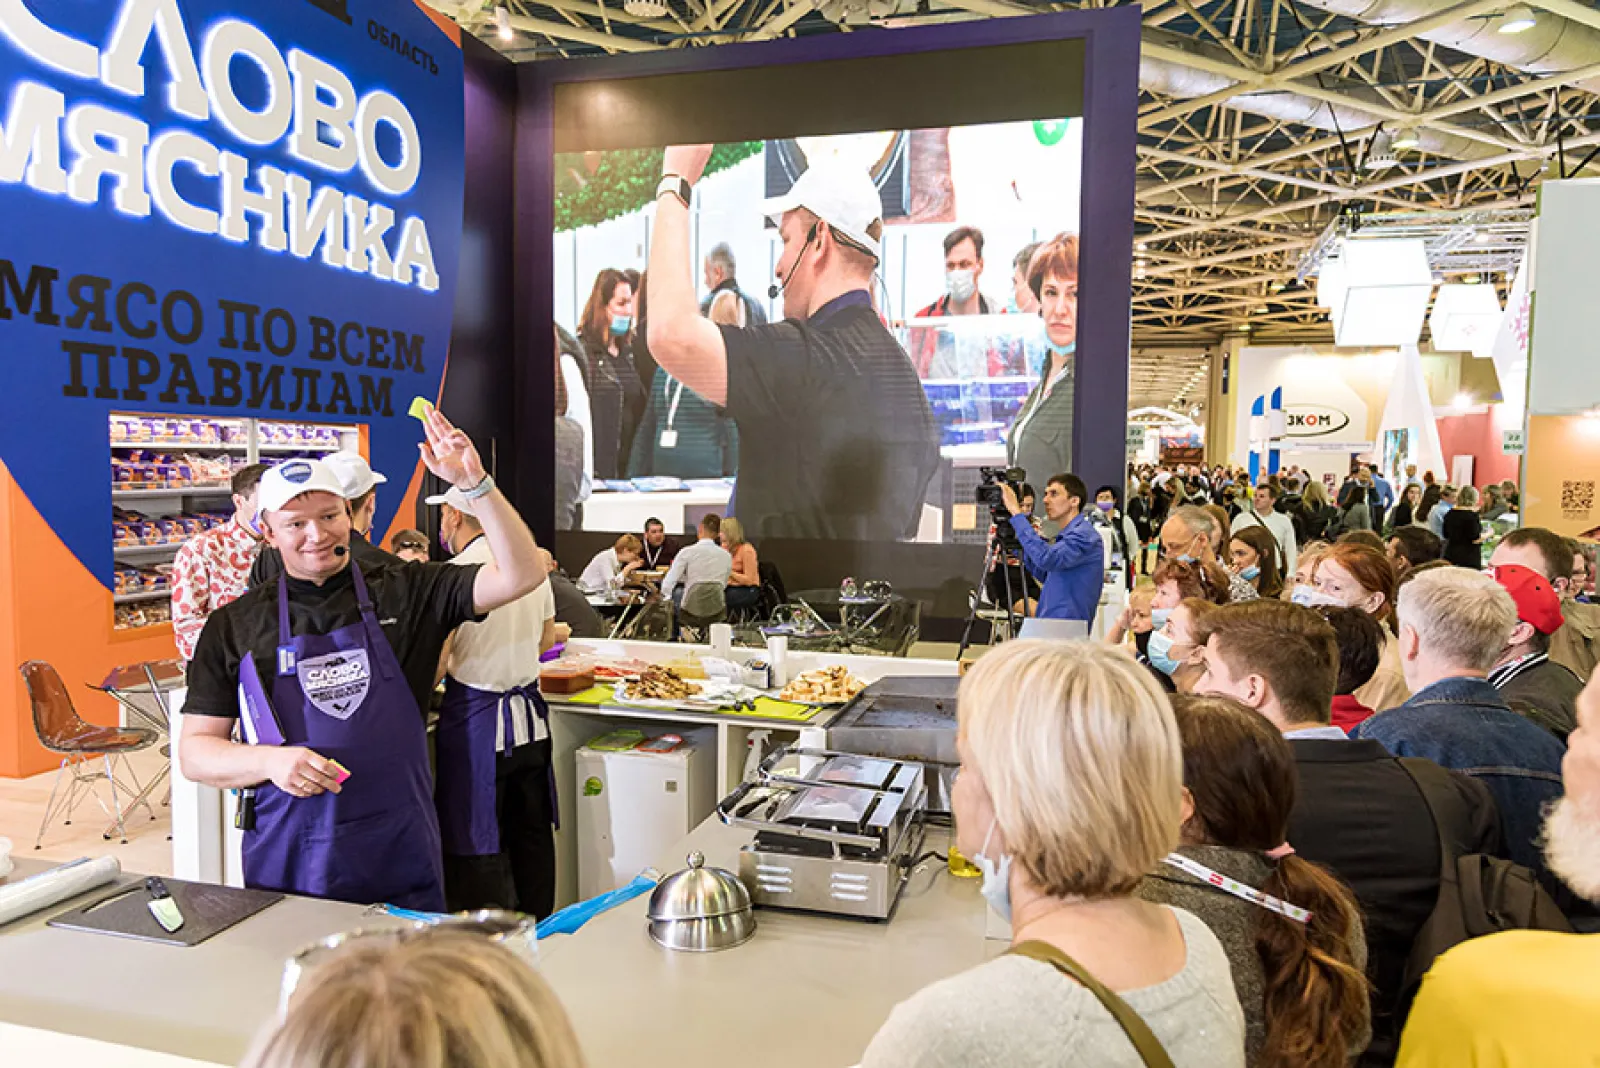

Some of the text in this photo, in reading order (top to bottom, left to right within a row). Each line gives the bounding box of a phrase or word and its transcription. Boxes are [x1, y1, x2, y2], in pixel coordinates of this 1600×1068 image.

[368, 19, 439, 75] ОБЛАСТЬ
[0, 259, 425, 374] МЯСО ПО ВСЕМ
[61, 340, 394, 417] ПРАВИЛАМ
